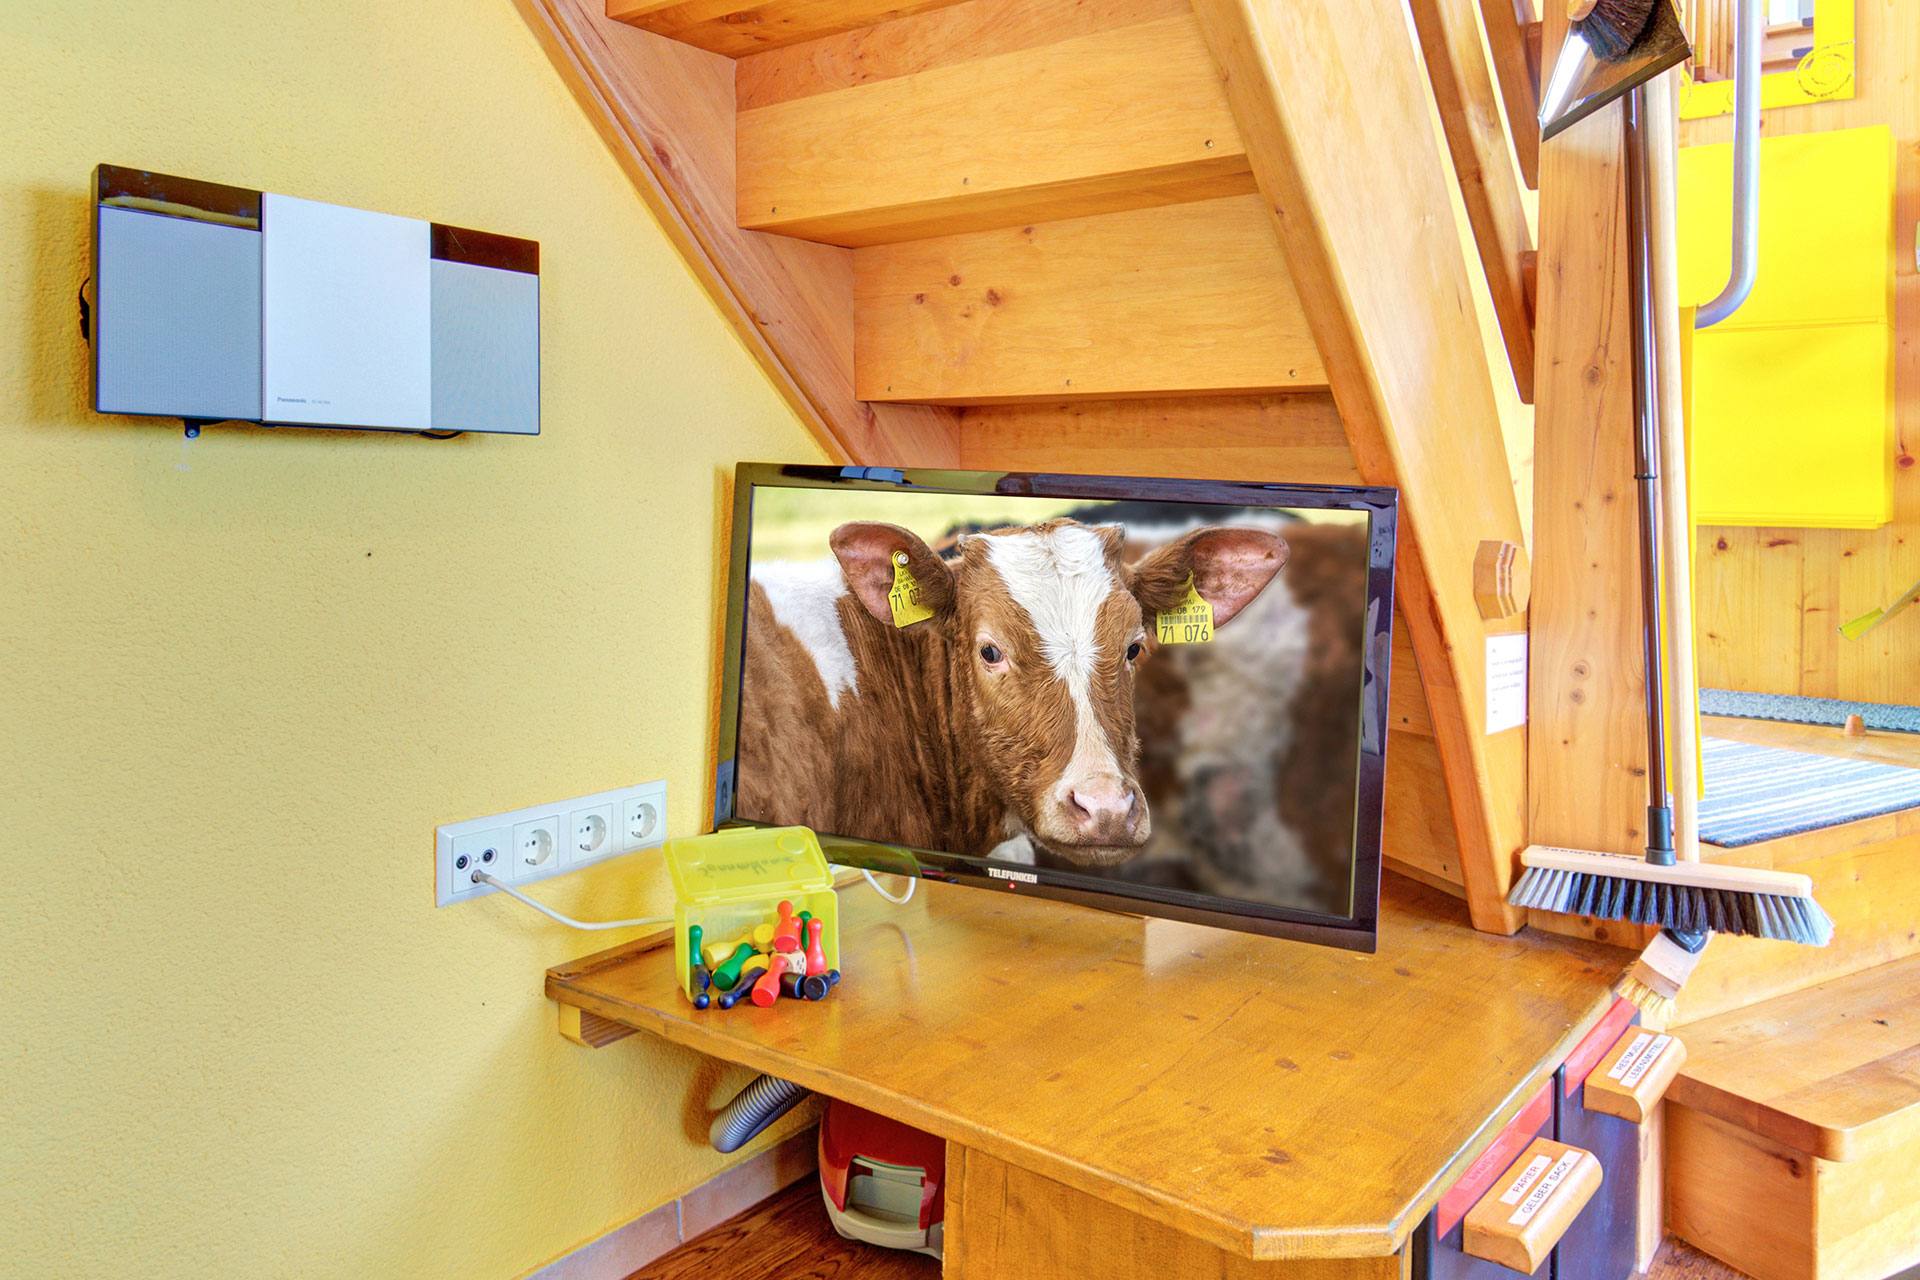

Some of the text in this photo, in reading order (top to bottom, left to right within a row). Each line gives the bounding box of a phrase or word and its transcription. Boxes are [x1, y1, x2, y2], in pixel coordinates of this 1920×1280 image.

[892, 587, 920, 612] 71 07
[1176, 606, 1188, 615] 08
[1192, 605, 1206, 614] 179
[1161, 624, 1209, 644] 71 076
[987, 867, 1038, 884] TELEFUNKEN
[1629, 1041, 1665, 1080] LEBENSMITTEL
[1512, 1165, 1541, 1194] PAPIER
[1521, 1161, 1571, 1214] GELBER SACK
